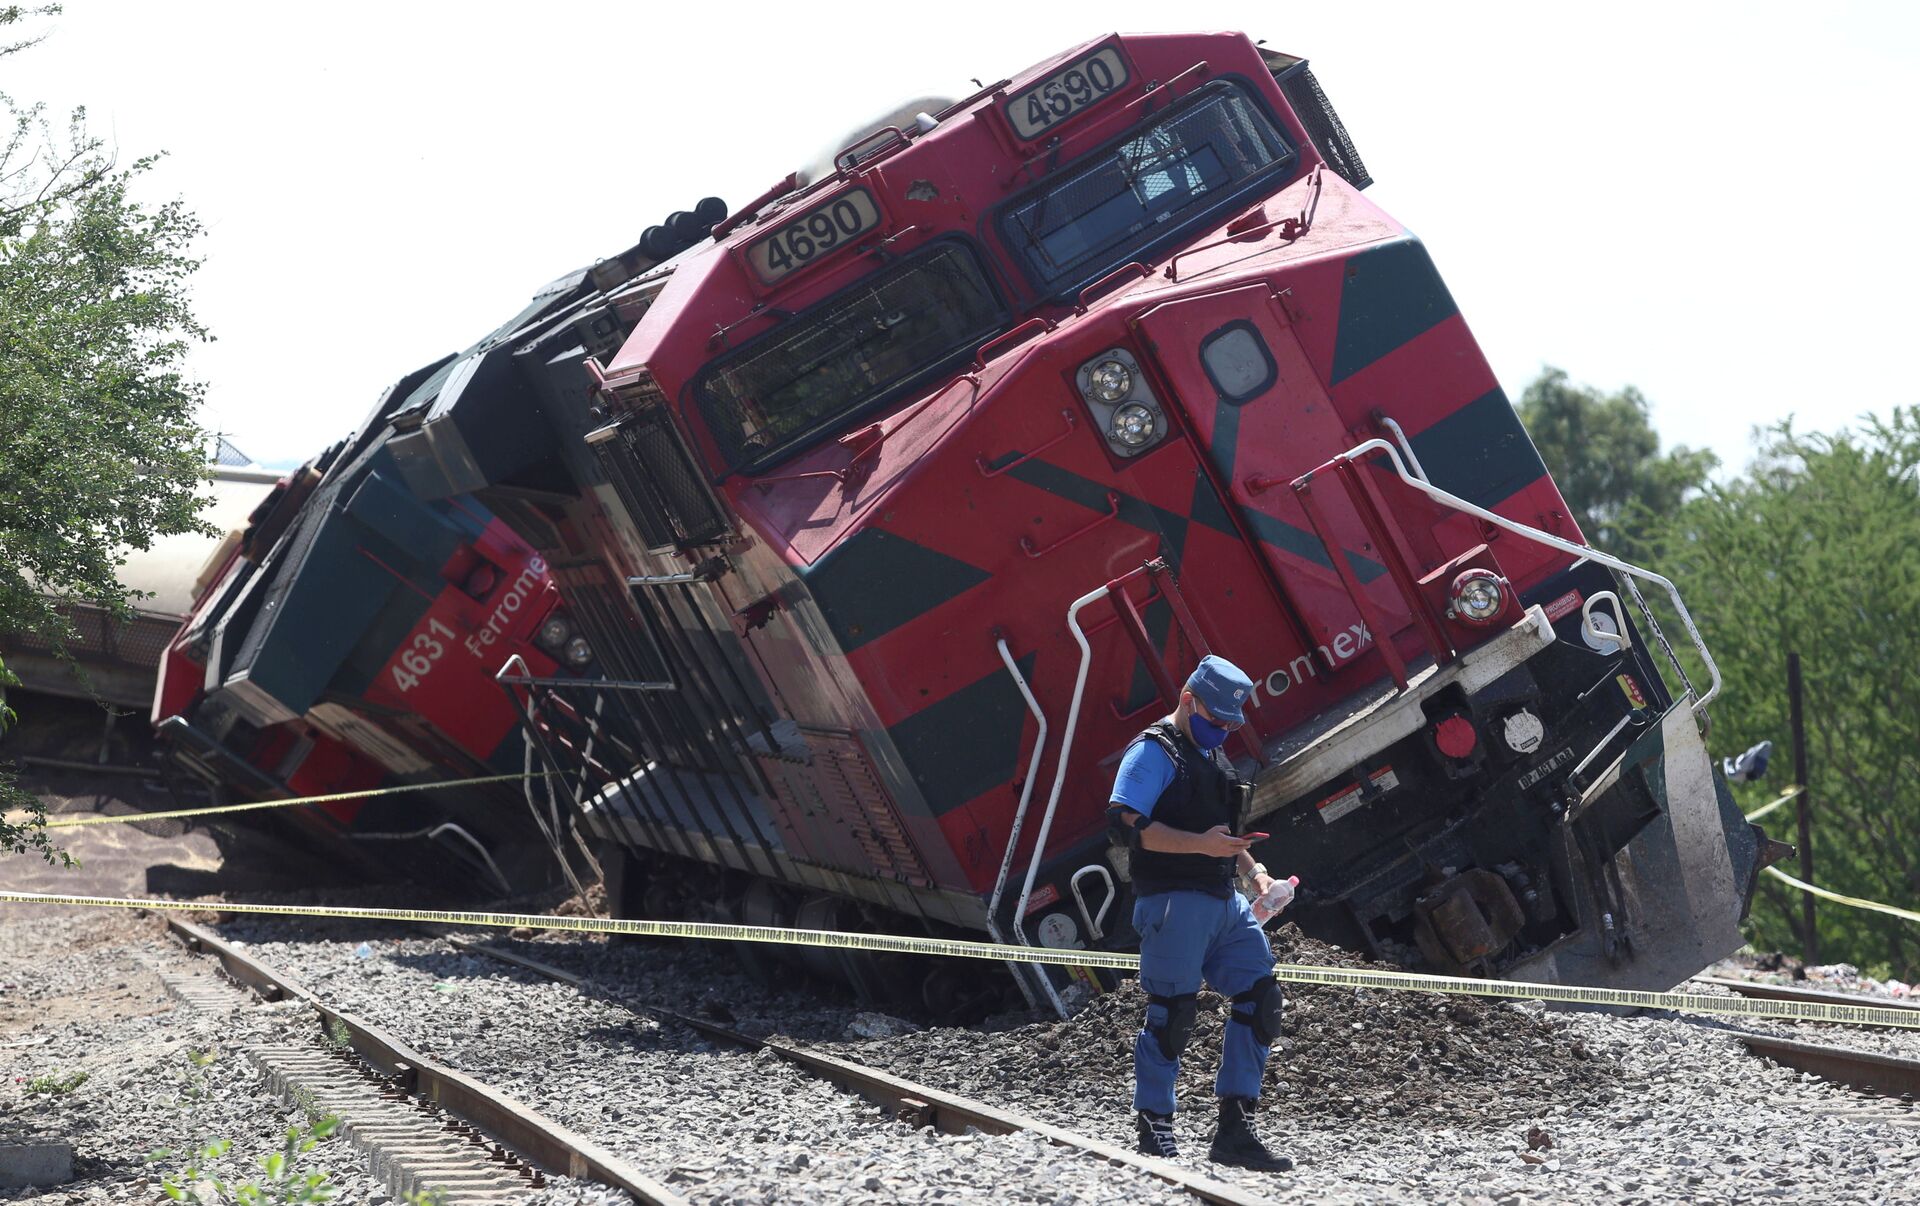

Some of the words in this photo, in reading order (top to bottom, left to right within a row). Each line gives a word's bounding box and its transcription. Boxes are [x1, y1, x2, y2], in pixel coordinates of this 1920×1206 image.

[1027, 58, 1114, 126] 4690
[768, 200, 862, 270] 4690
[464, 556, 547, 659] Ferrome
[391, 618, 456, 692] 4631
[1250, 619, 1372, 708] romex
[528, 917, 578, 927] PROHIBIDO
[581, 920, 615, 929] POLICIA
[616, 921, 628, 930] DE
[630, 922, 654, 932] LINEA
[659, 923, 681, 933] PASO
[684, 925, 692, 934] EL
[695, 925, 744, 938] PROHIBIDO
[746, 928, 781, 940] POLICIA
[783, 931, 794, 941] DE
[796, 932, 821, 943] LINEA
[825, 934, 848, 944] PASO
[850, 936, 858, 945] EL
[861, 937, 910, 949] PROHIBIDO
[912, 941, 947, 953] POLICIA
[1491, 984, 1514, 994] PASO
[1517, 986, 1525, 995] EL
[1528, 987, 1577, 999] PROHIBIDO
[1580, 990, 1615, 1001] POLICIA
[1617, 992, 1628, 1002] DE
[1630, 993, 1655, 1005] LINEA
[1659, 994, 1683, 1007] PASO
[1686, 996, 1694, 1008] EL
[1696, 997, 1747, 1011] PROHIBIDO
[1749, 1000, 1785, 1014] POLICIA
[1787, 1003, 1798, 1015] DE
[1800, 1004, 1825, 1017] LINEA
[1829, 1006, 1853, 1019] PASO
[1857, 1008, 1865, 1020] EL
[1868, 1009, 1919, 1025] PROHIBIDO
